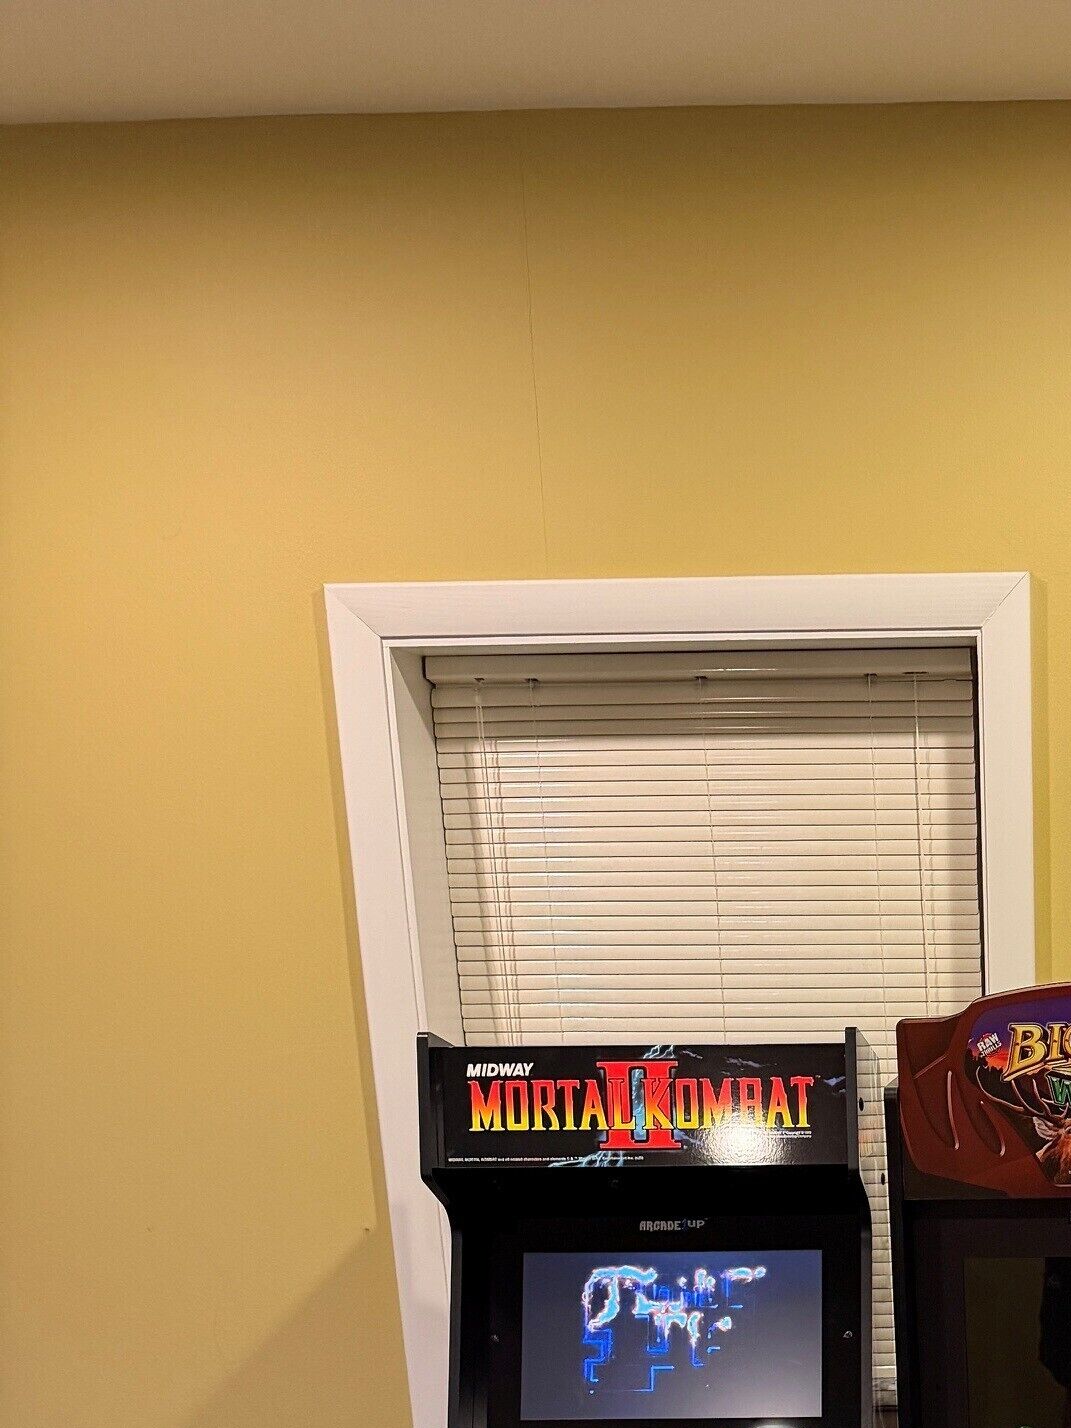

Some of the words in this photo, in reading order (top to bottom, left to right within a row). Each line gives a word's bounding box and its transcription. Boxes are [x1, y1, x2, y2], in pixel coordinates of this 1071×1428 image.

[466, 1063, 534, 1077] MIDWAY
[468, 1080, 636, 1131] MORTAL
[640, 1075, 814, 1130] KOMBAT
